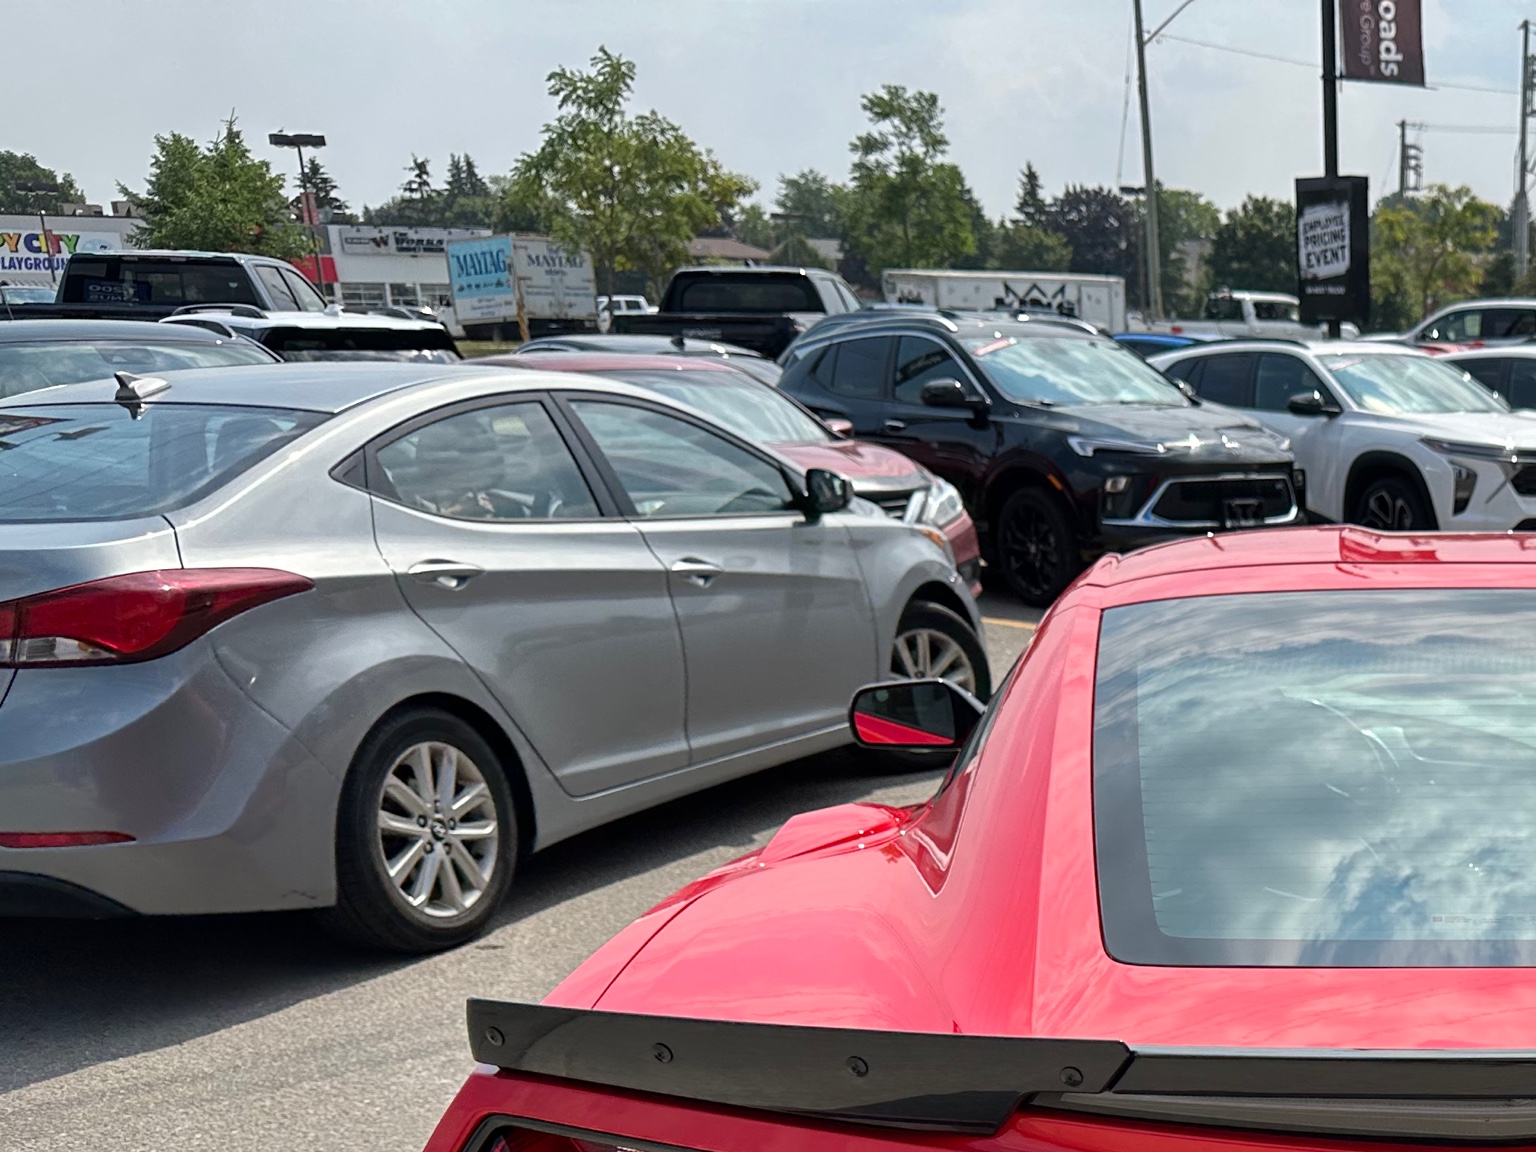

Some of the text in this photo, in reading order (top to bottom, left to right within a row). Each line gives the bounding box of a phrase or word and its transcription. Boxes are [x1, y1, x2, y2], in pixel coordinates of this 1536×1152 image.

[1358, 14, 1375, 66] Group
[1378, 0, 1403, 76] oads
[24, 232, 80, 254] CITY
[1304, 228, 1346, 249] PRICING
[451, 248, 507, 278] MAYTAG
[1305, 245, 1346, 268] EVENT
